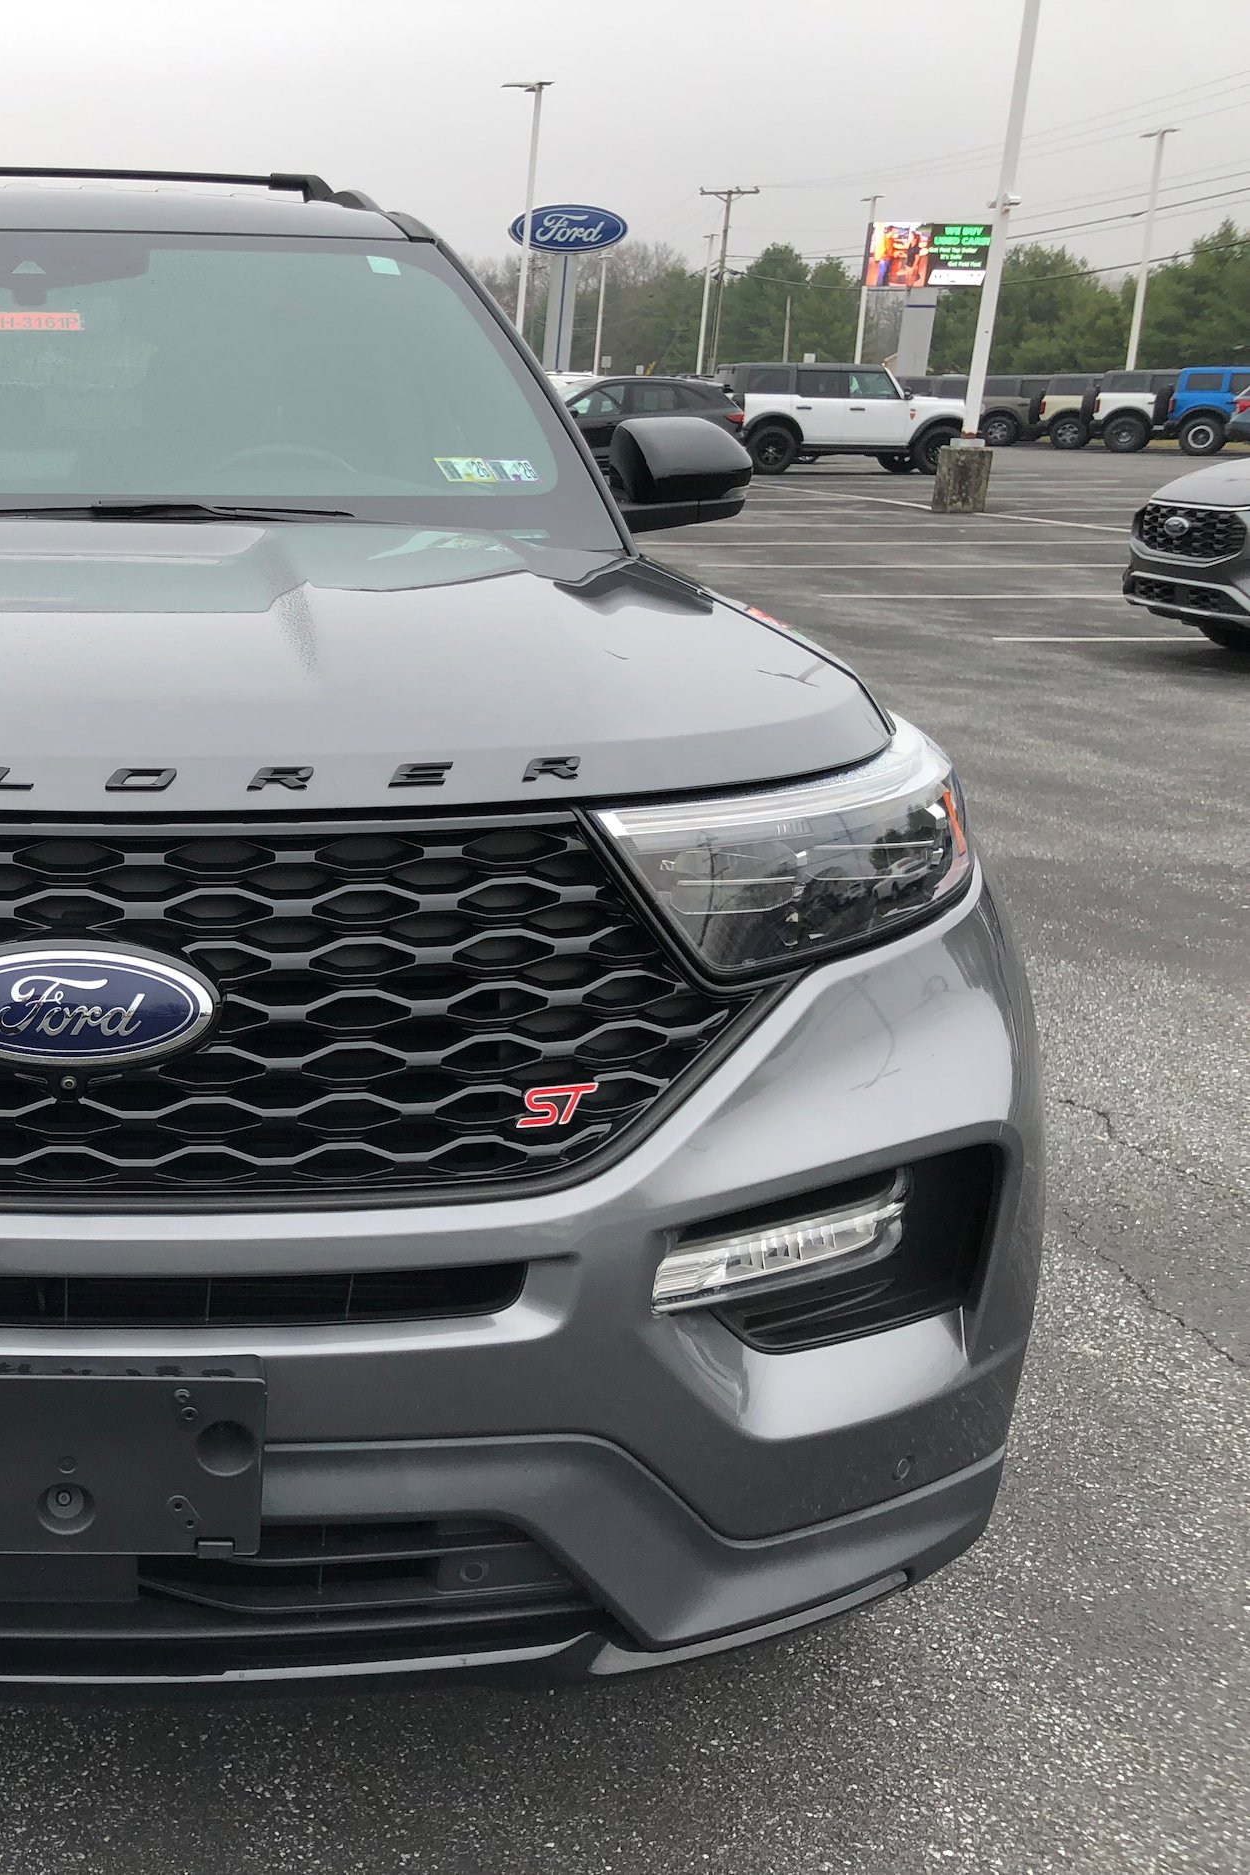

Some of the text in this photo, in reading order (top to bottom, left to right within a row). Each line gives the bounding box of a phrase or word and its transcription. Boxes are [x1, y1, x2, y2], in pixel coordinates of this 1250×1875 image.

[535, 213, 605, 243] Ford
[470, 461, 491, 478] 26
[518, 462, 537, 479] 26
[516, 1082, 599, 1129] ST
